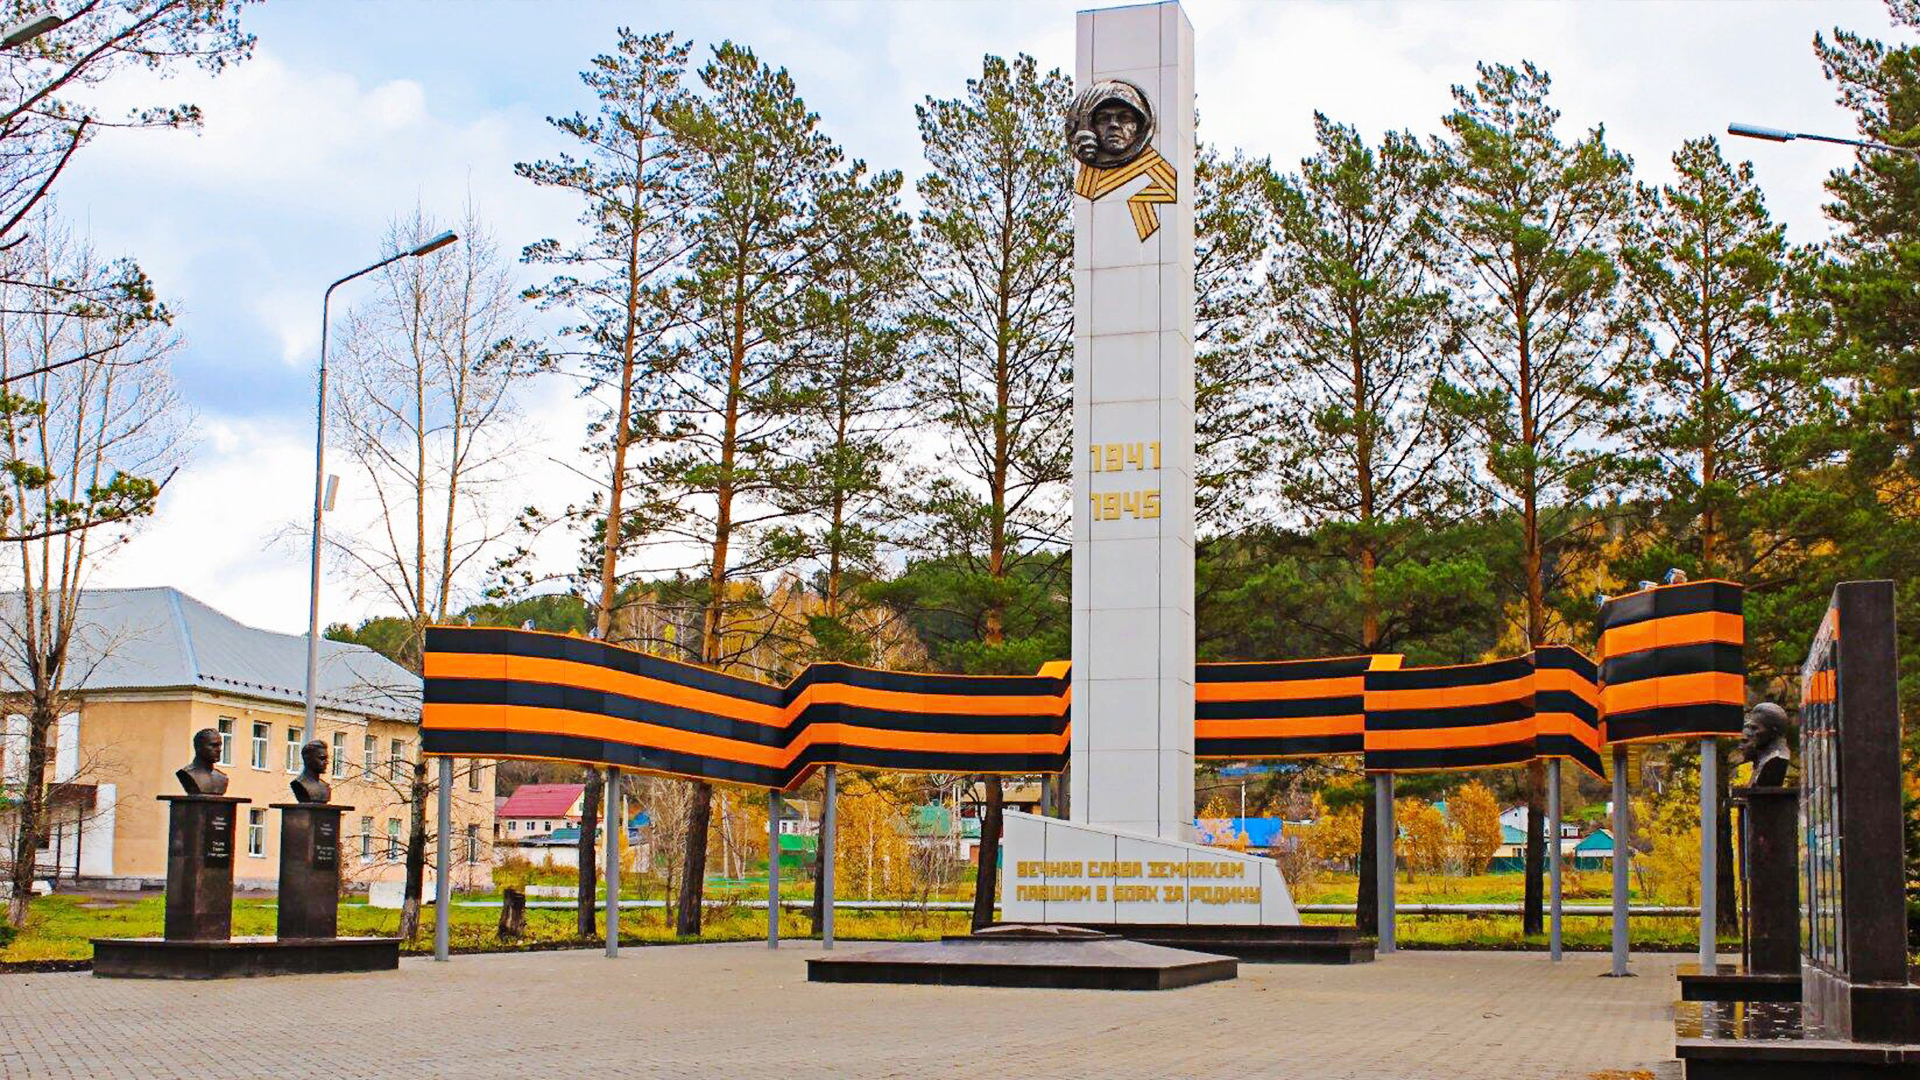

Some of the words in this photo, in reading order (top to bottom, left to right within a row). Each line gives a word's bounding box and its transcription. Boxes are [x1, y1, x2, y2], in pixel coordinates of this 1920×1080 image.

[1090, 442, 1161, 472] 1941
[1090, 490, 1161, 522] 1945
[1016, 861, 1083, 878] ВЕЧНАЯ
[1088, 861, 1143, 878] СЛАВА
[1147, 861, 1245, 878] ЗЕМЛЯКАМ
[1016, 885, 1091, 902] ПАВШИМ
[1096, 885, 1107, 902] В
[1113, 885, 1159, 902] БОЯХ
[1163, 885, 1185, 902] ЗА
[1189, 885, 1262, 904] РОДИНУ
